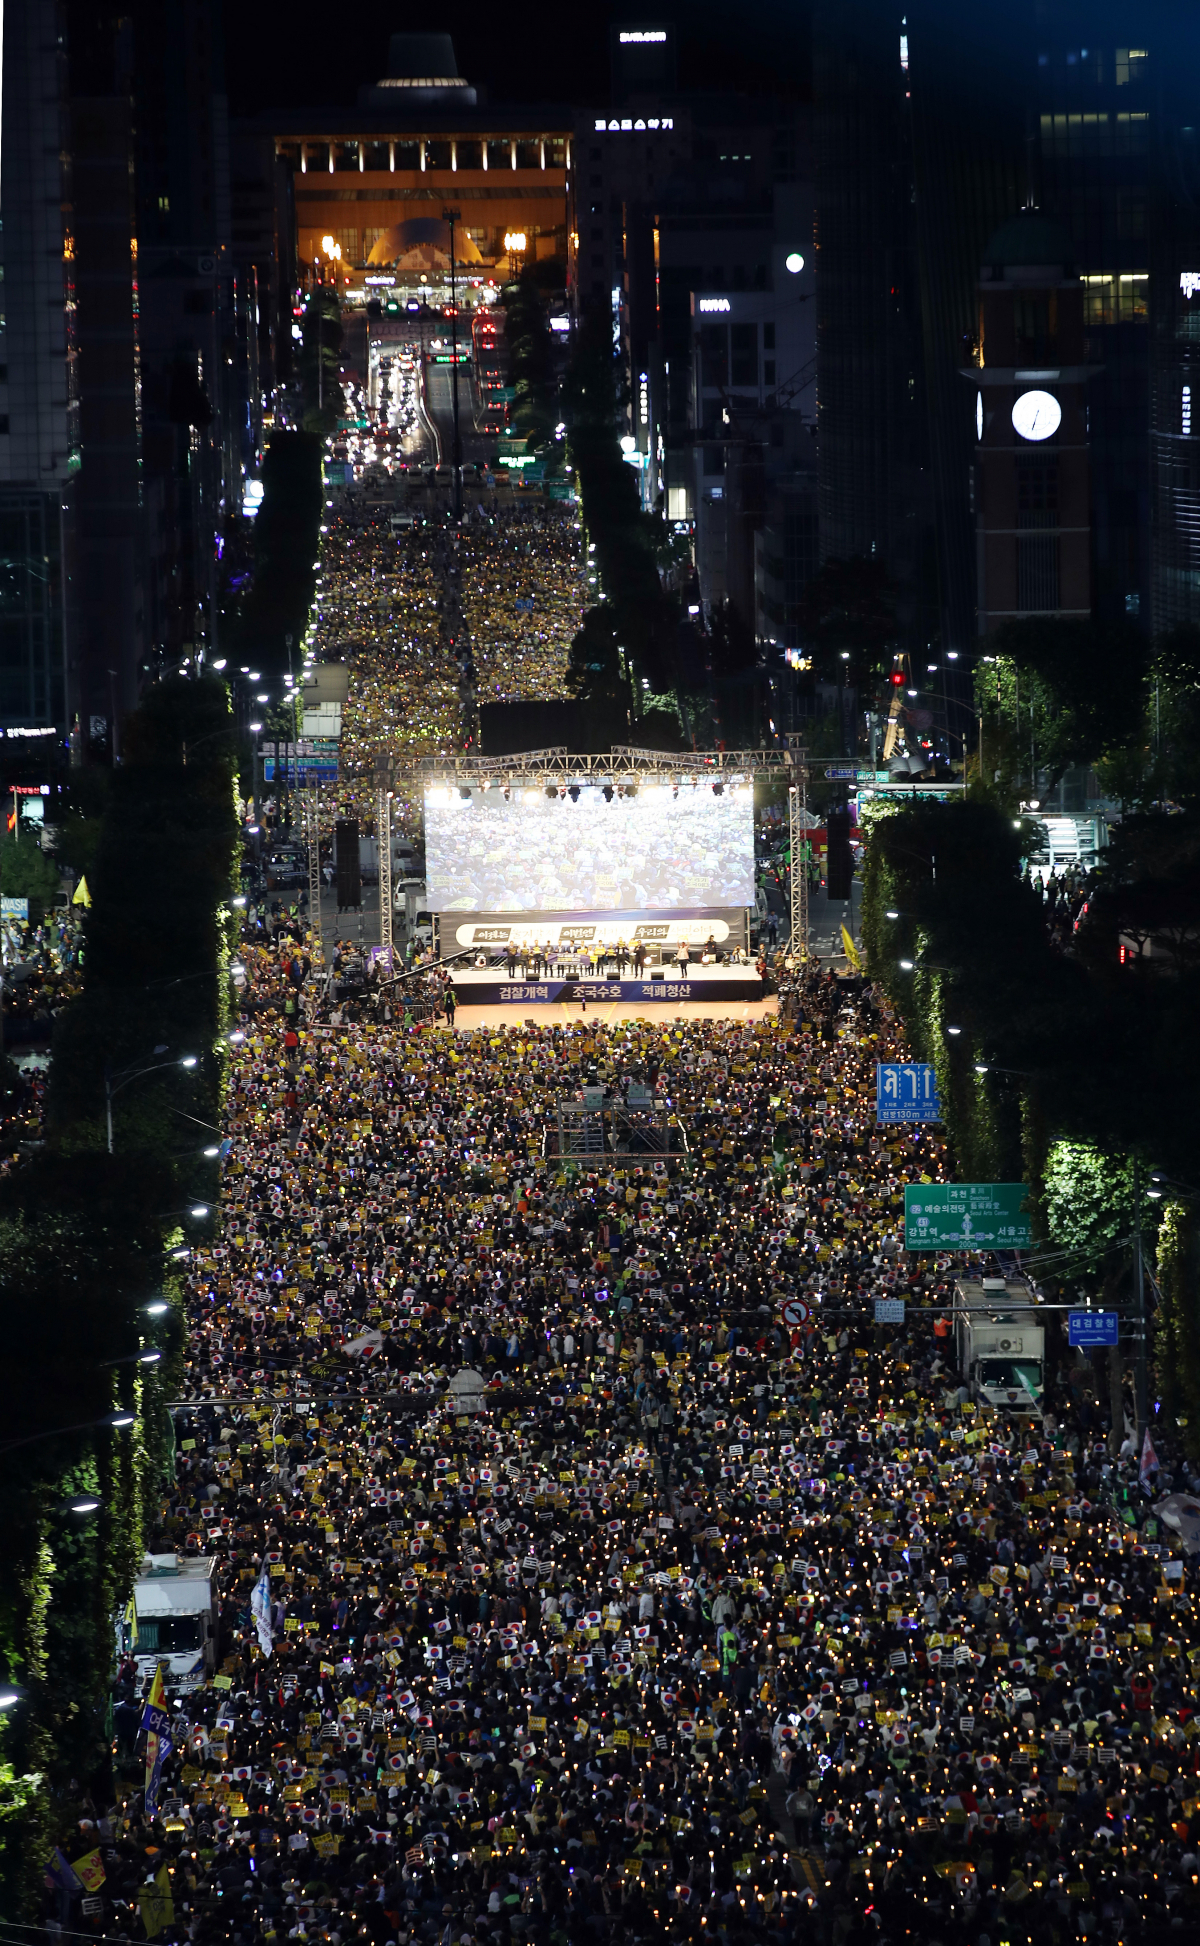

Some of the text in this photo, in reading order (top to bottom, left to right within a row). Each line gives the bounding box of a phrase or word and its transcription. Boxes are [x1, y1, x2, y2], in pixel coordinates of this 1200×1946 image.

[2, 899, 27, 911] WASH
[636, 926, 667, 937] 우리의
[499, 984, 691, 1000] 검찰개혁 조국수호 적폐청산
[950, 1190, 967, 1199] 과천
[924, 1204, 966, 1214] 예술의전당
[908, 1227, 938, 1237] 강남역
[908, 1238, 931, 1246] Gangnam
[959, 1240, 978, 1248] 200m
[1012, 1237, 1025, 1245] High
[1072, 1318, 1114, 1328] 대검찰청
